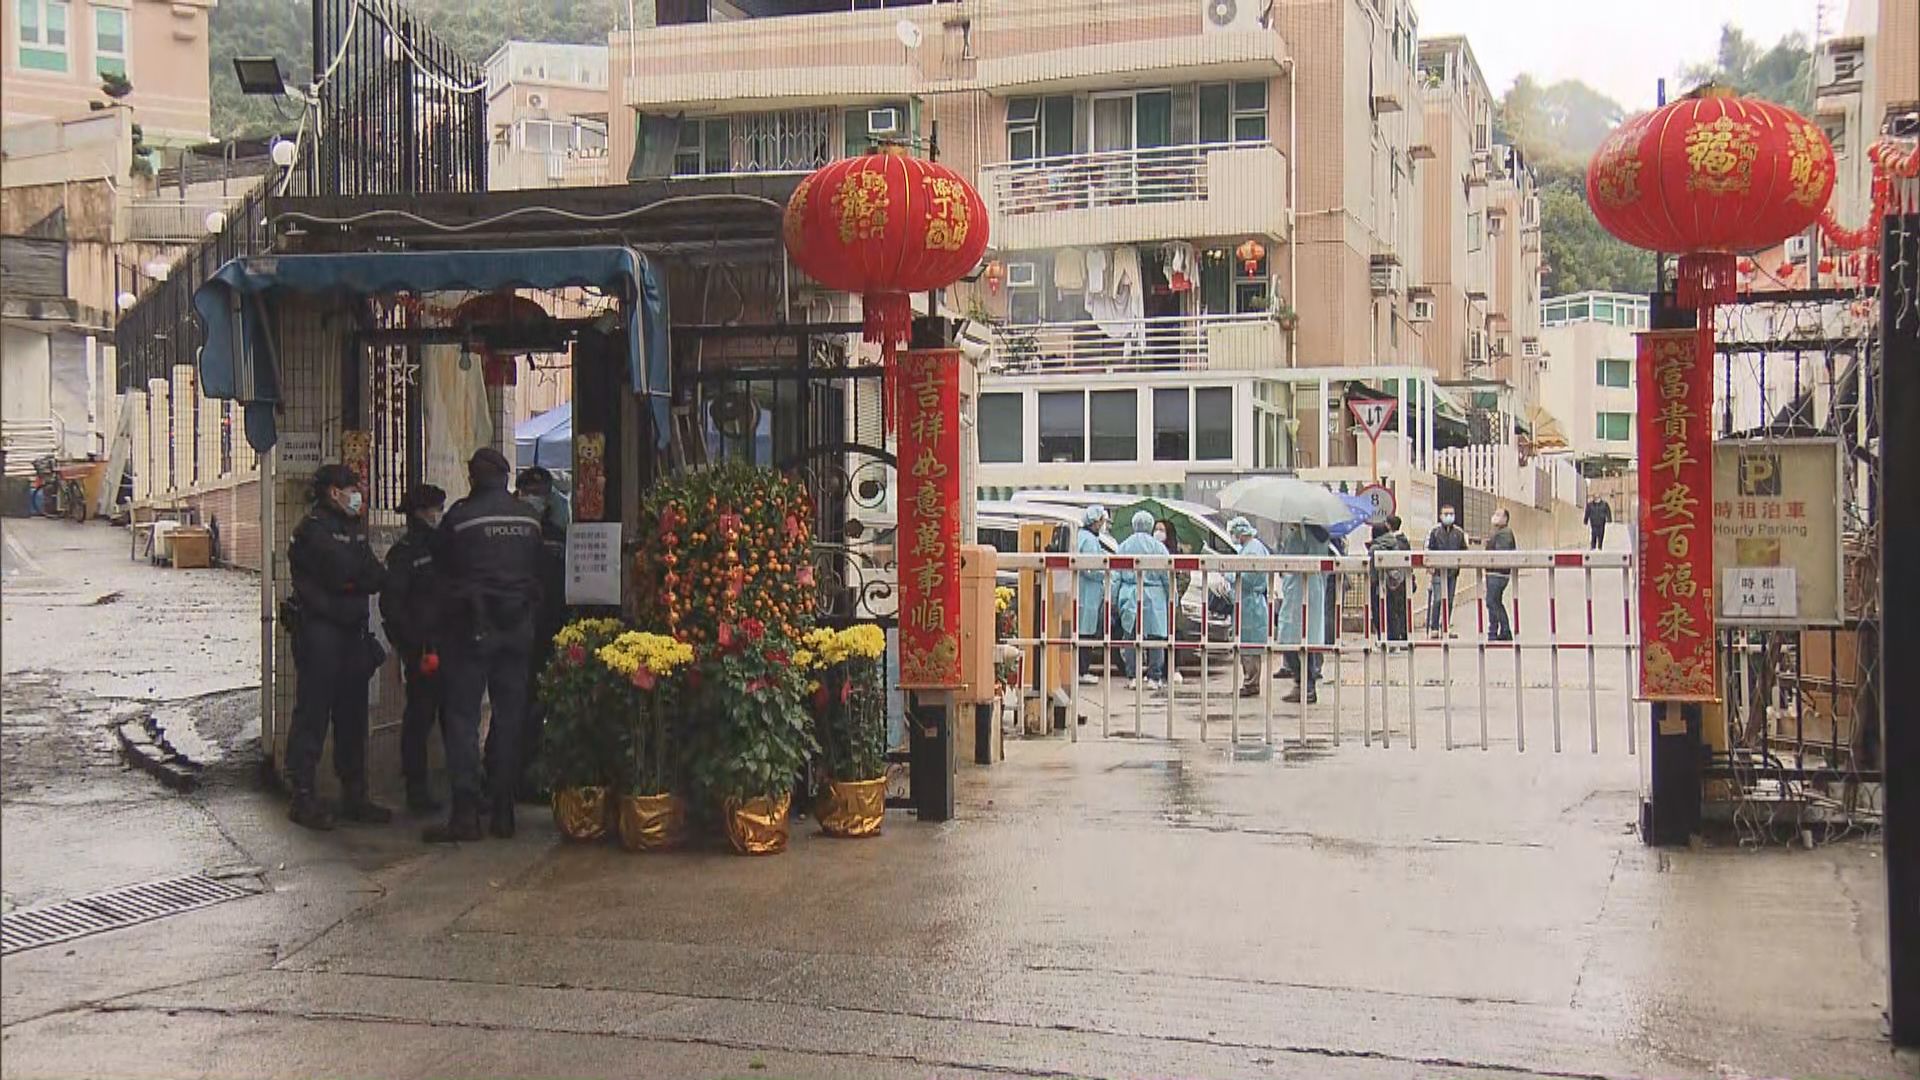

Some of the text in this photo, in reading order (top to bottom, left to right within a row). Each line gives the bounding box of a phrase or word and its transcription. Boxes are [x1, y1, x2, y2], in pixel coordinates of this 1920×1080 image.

[910, 371, 948, 632] 吉祥如意萬事順
[1371, 493, 1380, 507] 8
[1651, 358, 1700, 643] 富貴平安百福來
[1713, 501, 1806, 519] 時租泊車
[492, 525, 524, 537] POLICE
[1713, 523, 1807, 537] Hourly Parking
[1742, 594, 1755, 604] 14
